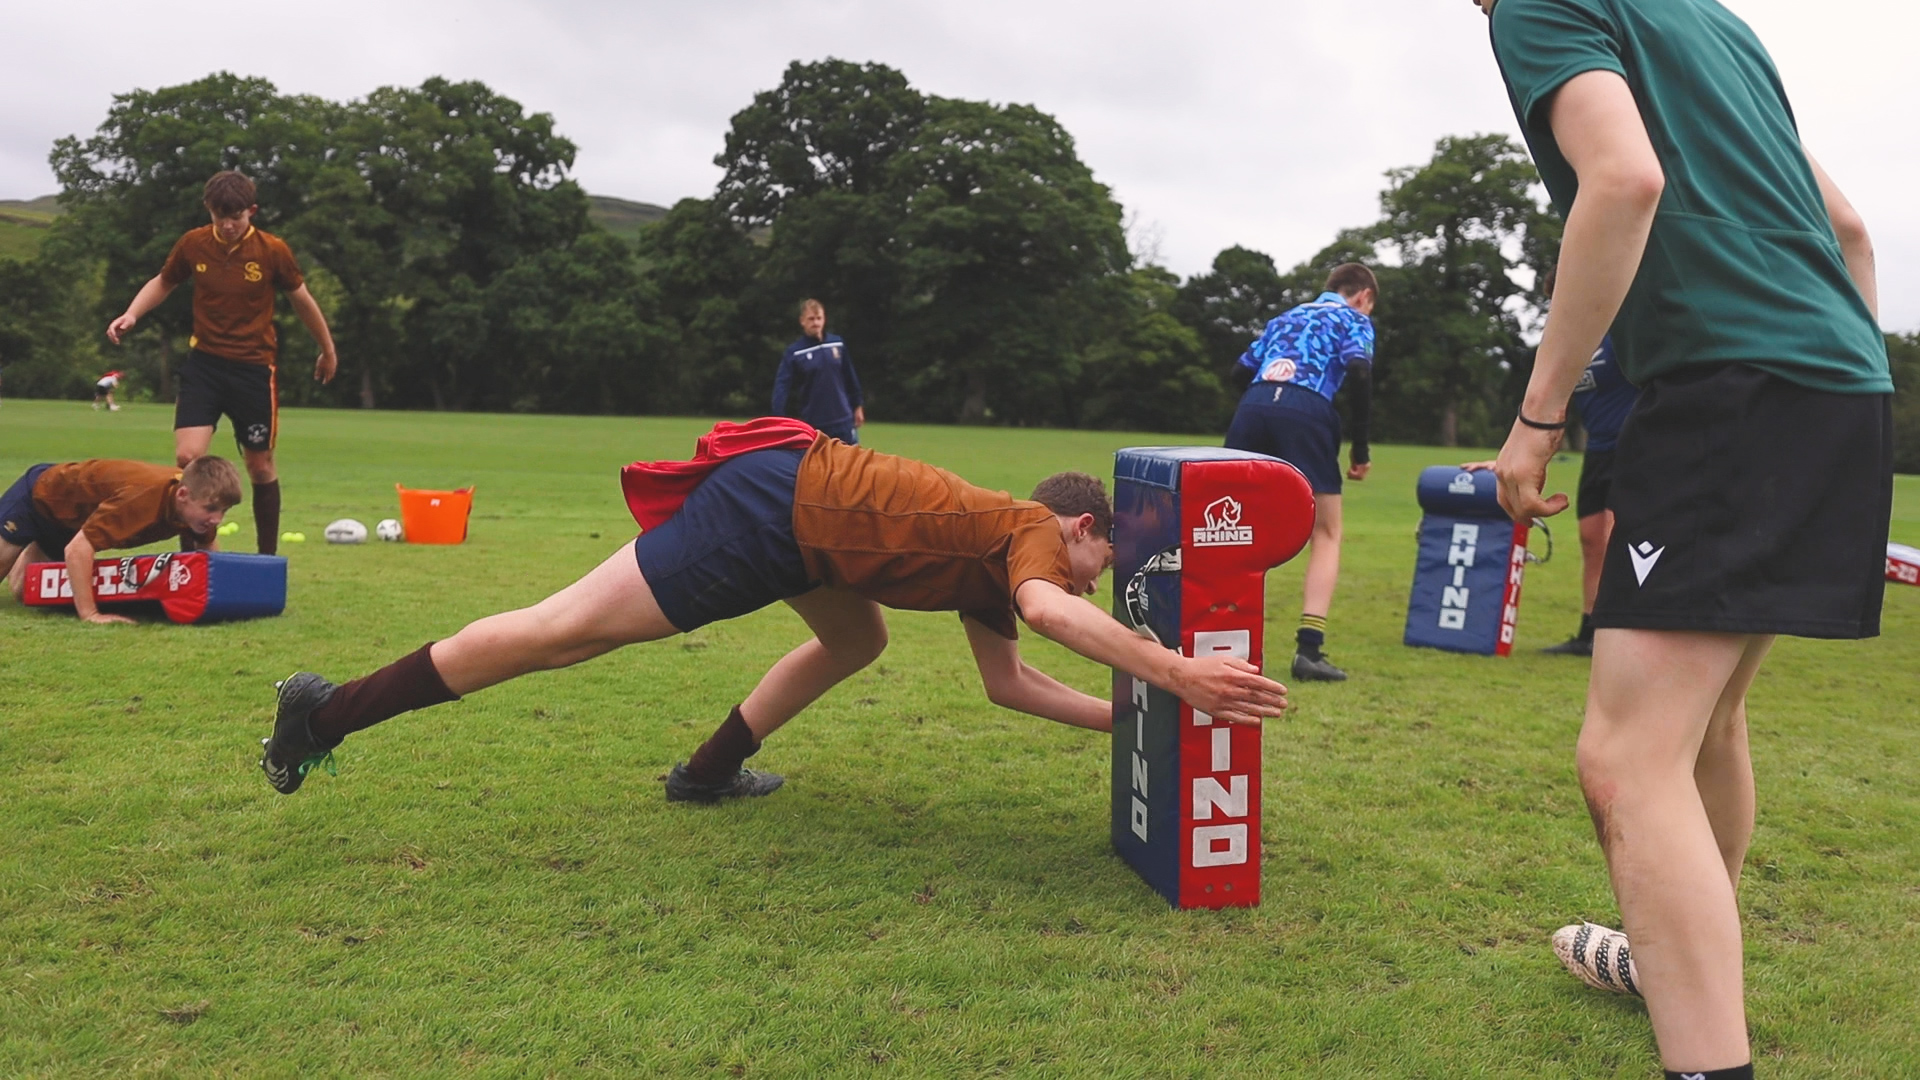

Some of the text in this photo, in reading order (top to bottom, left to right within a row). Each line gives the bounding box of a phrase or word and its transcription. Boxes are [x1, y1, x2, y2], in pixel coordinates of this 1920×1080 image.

[1193, 529, 1253, 543] RHINO
[1438, 523, 1479, 630] RHINO
[1500, 544, 1525, 644] RHINO
